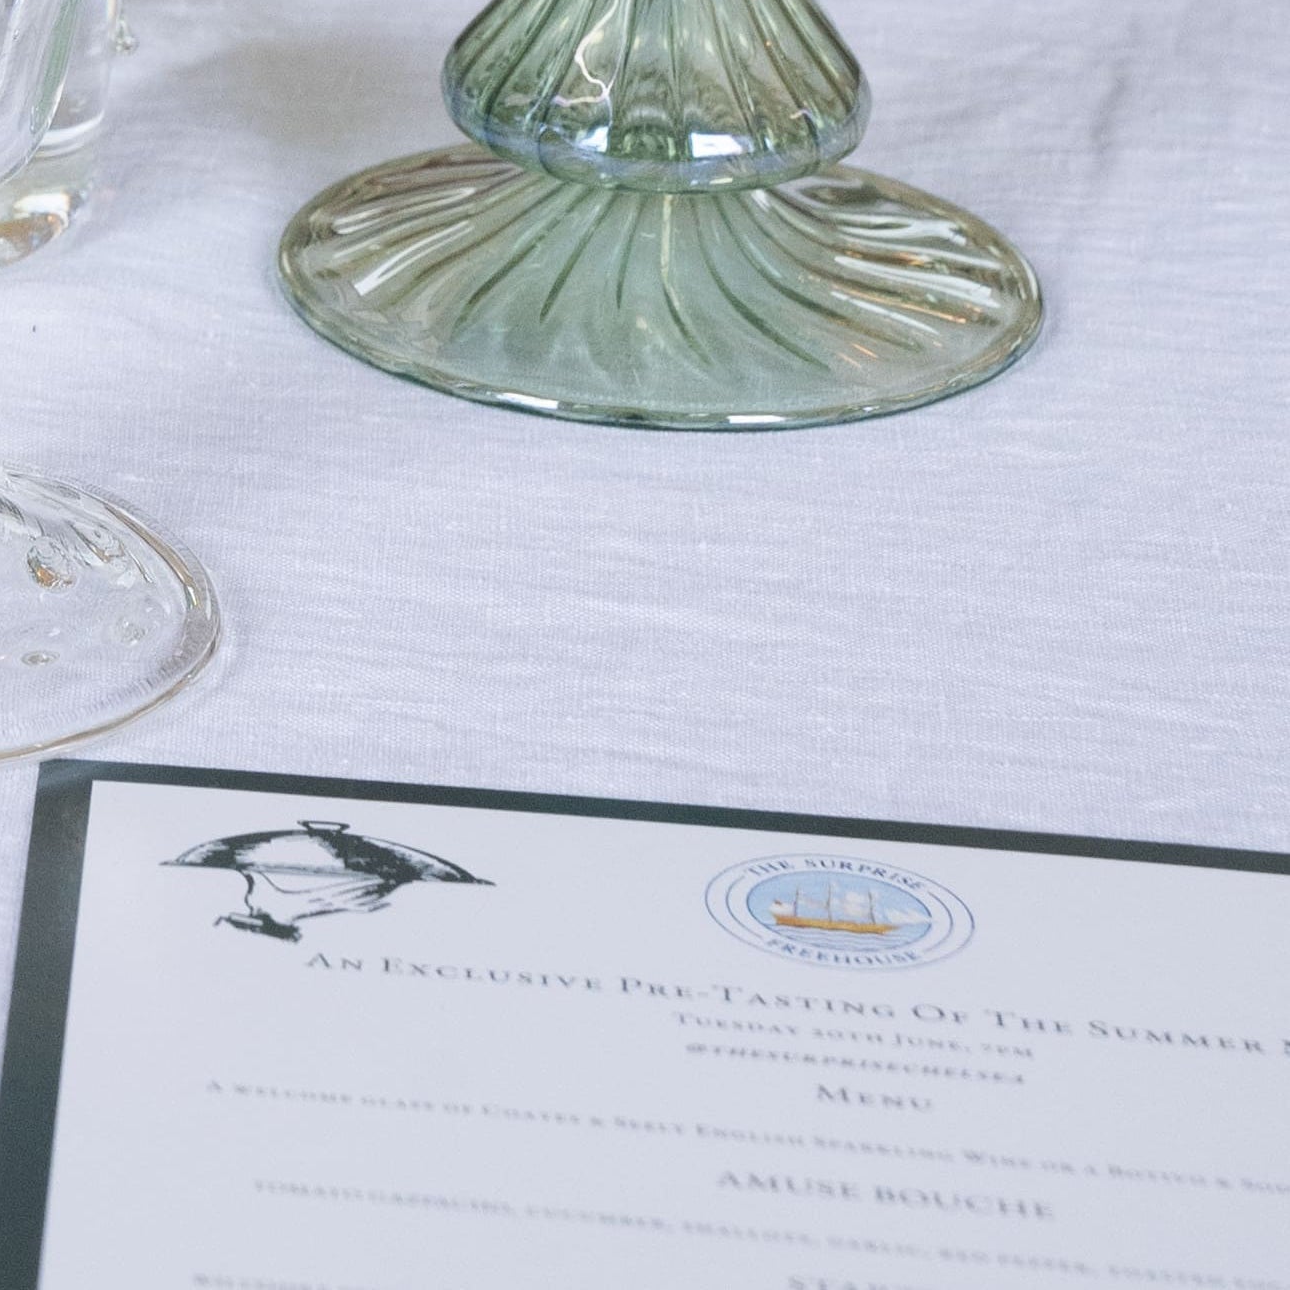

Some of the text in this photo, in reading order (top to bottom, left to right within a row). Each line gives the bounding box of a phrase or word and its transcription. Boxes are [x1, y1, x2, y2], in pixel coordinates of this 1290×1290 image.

[744, 858, 926, 891] THE SURPRISE
[767, 938, 919, 966] FREEHOUSE
[306, 952, 363, 972] AN
[382, 956, 602, 991] EXCLUSIVE
[620, 976, 895, 1018] PRE-TASTING
[911, 1005, 967, 1025] OF
[981, 1007, 1071, 1036] THE
[1087, 1020, 1265, 1054] SUMMER
[672, 1011, 798, 1036] TUESDAY
[441, 1102, 474, 1117] OF
[814, 1082, 932, 1111] MENU
[717, 1170, 1054, 1221] AMUSE BOUCHE
